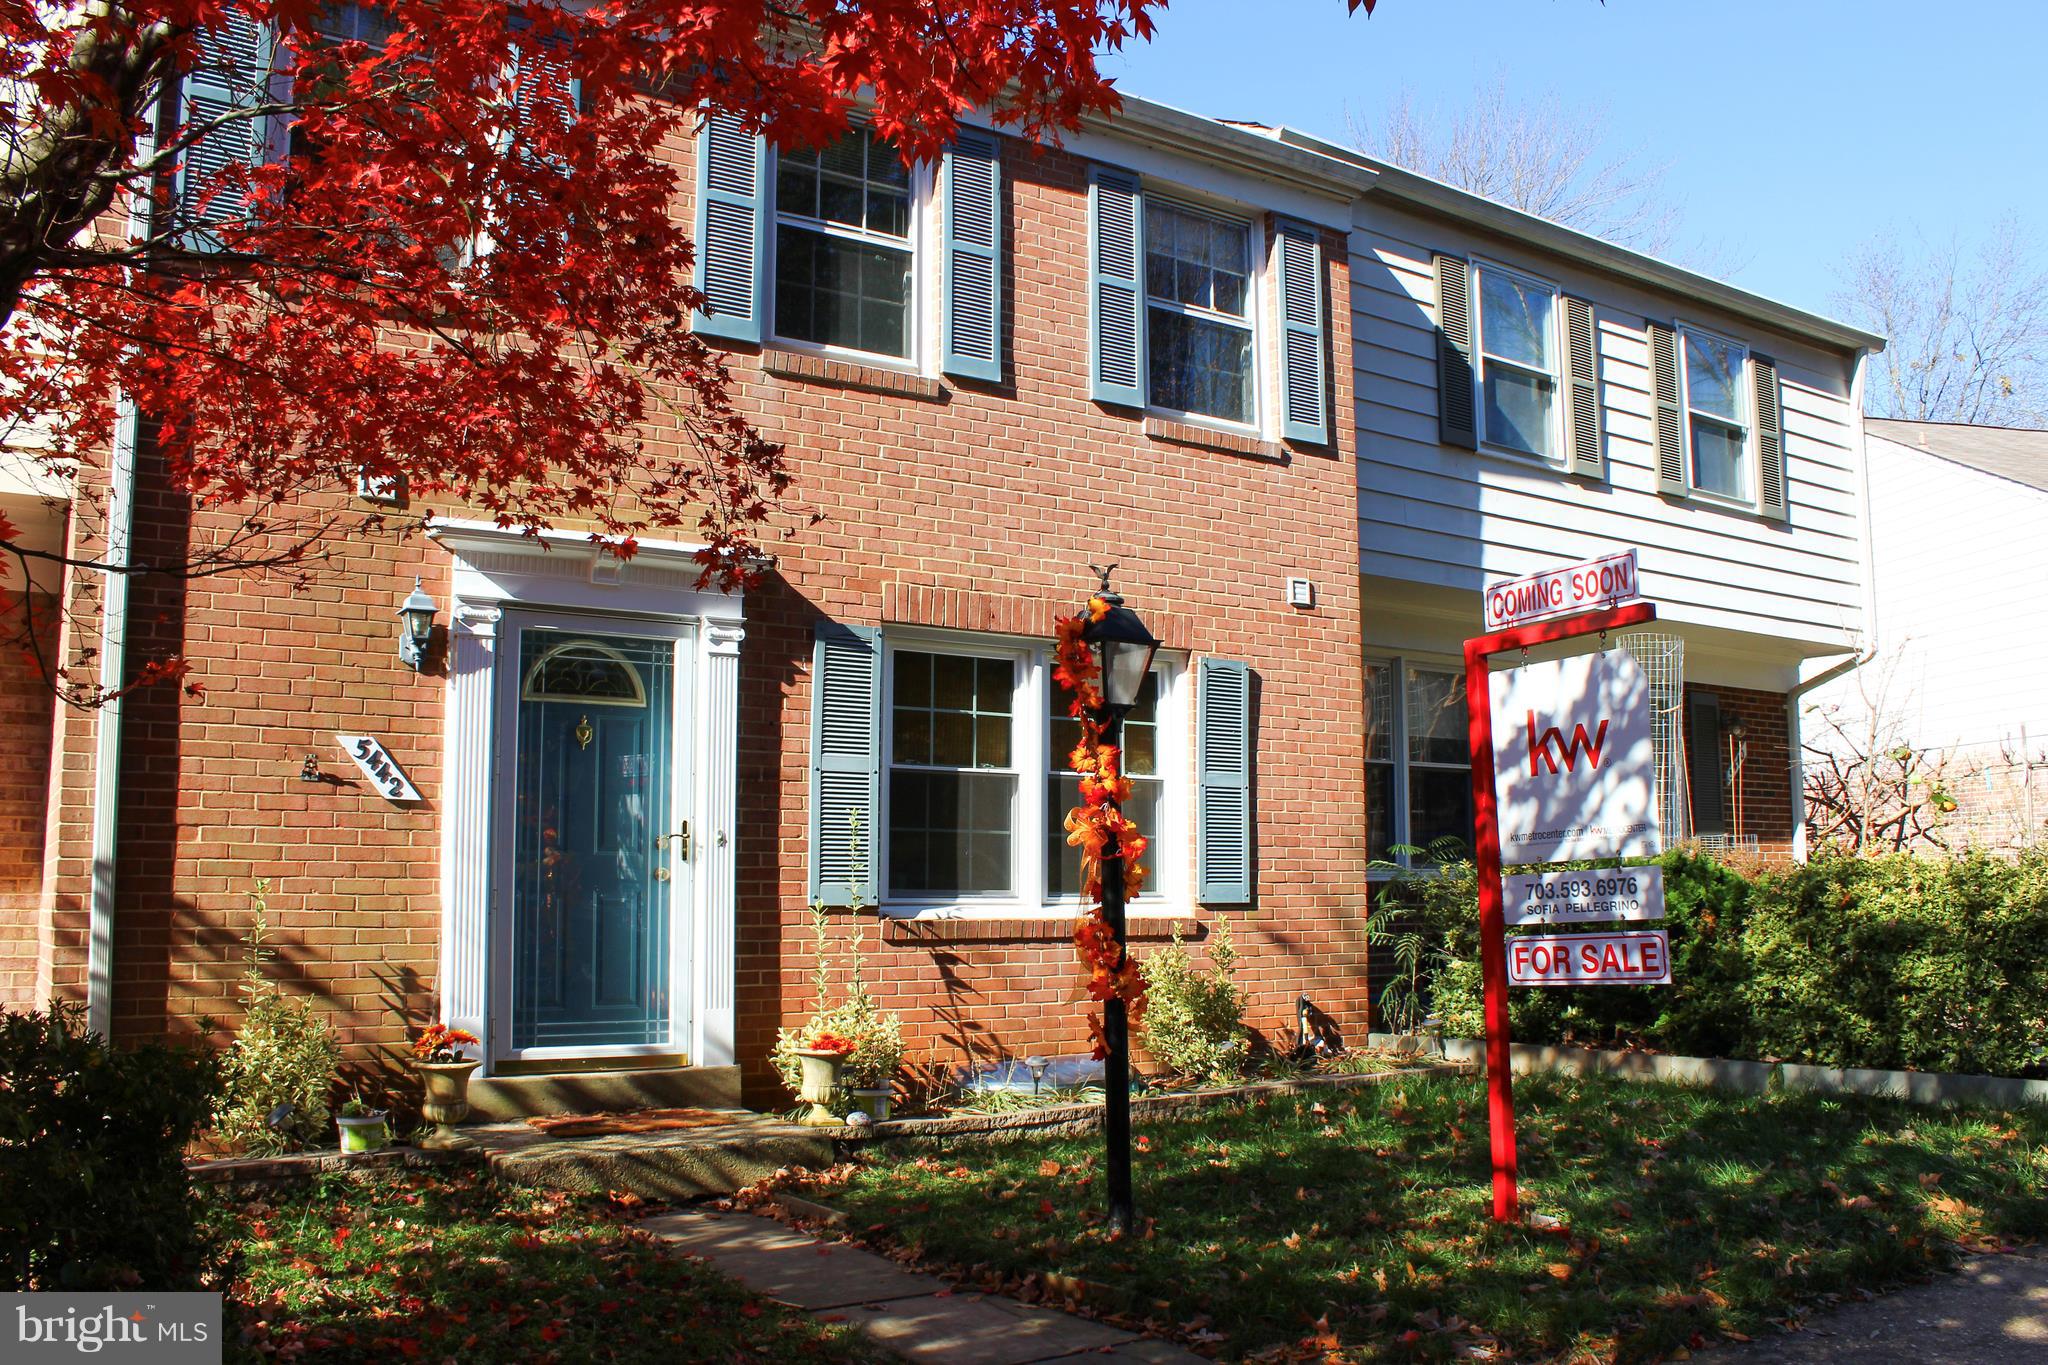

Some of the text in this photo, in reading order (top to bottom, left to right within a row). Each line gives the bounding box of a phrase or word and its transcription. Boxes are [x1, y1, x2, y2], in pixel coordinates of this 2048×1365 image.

[1493, 562, 1628, 619] COMING SOON
[1510, 828, 1584, 842] kwmetrocenter.com
[1525, 877, 1638, 900] 703.593.6976
[1527, 900, 1639, 915] SOFIA PELLEGRINO
[1515, 942, 1660, 975] FOR SALE
